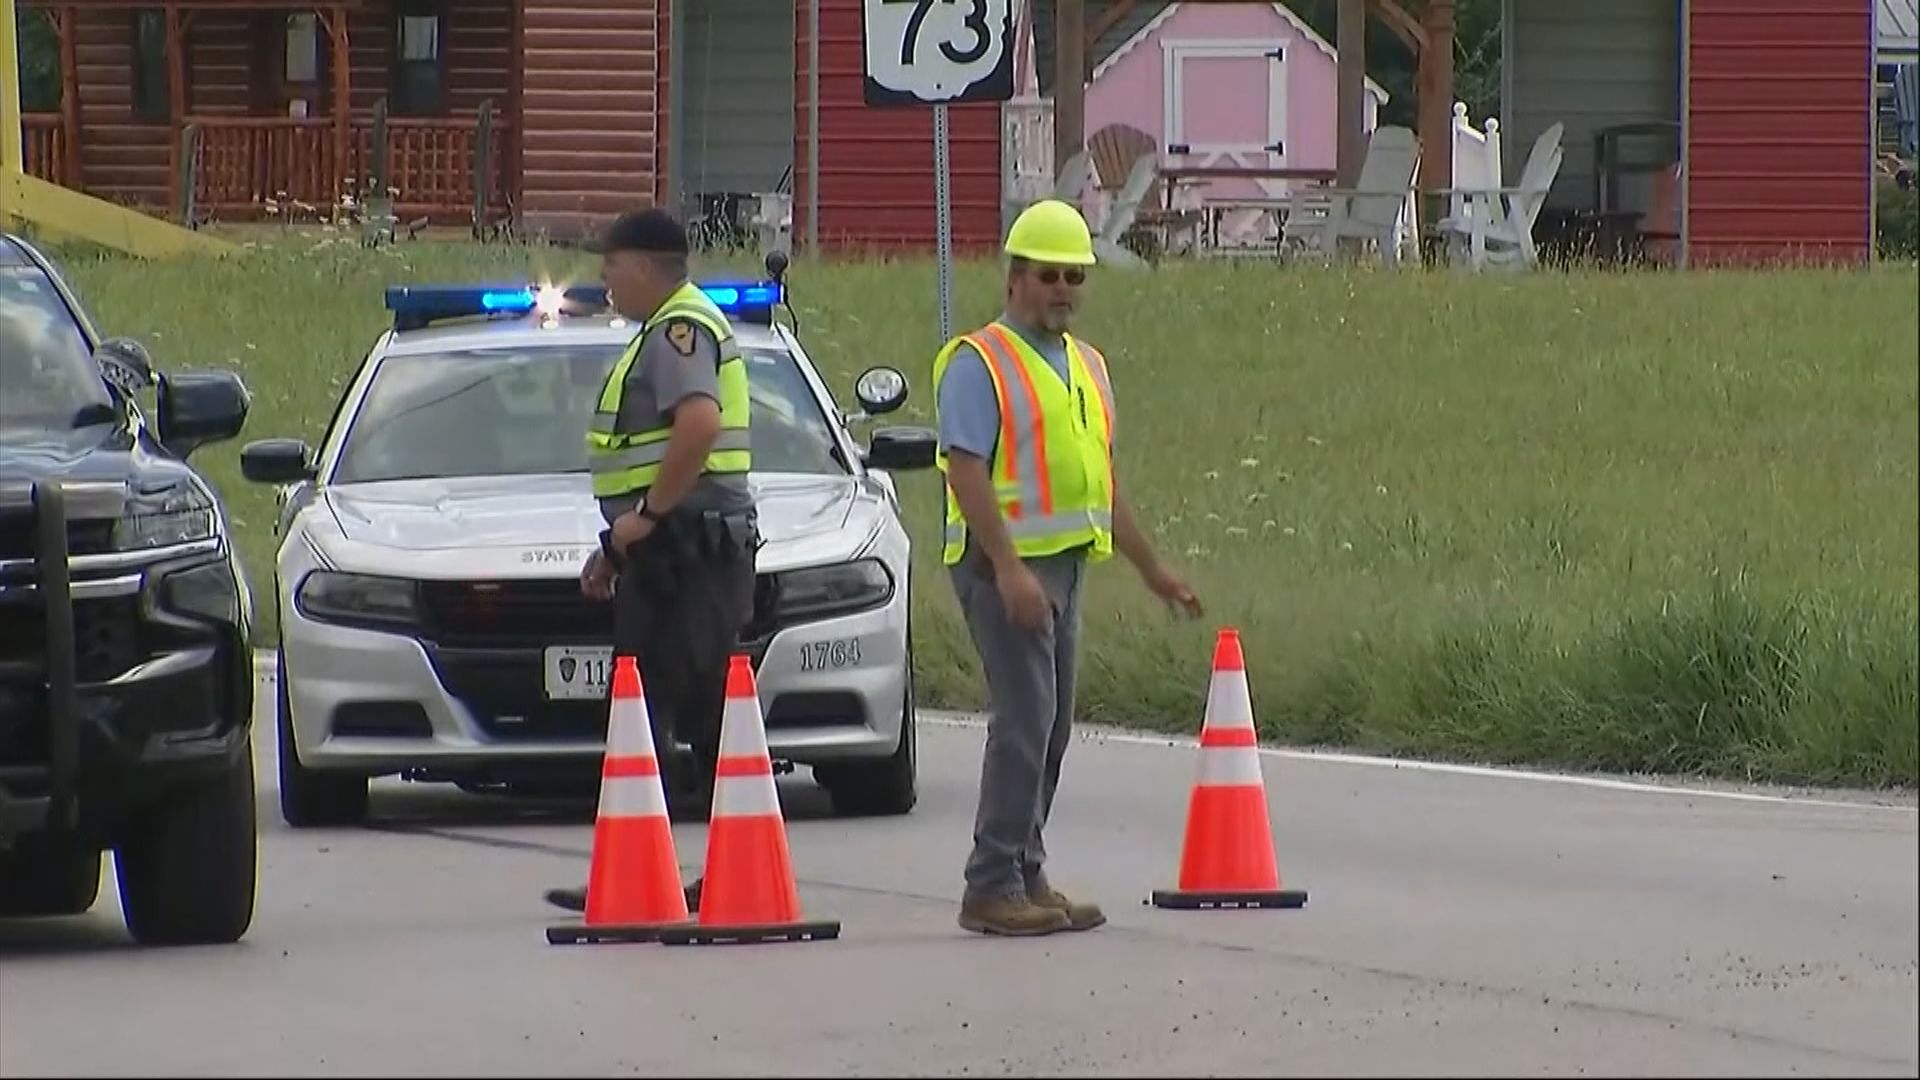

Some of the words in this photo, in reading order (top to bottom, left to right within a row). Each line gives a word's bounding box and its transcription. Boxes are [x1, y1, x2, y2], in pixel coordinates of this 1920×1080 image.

[882, 0, 991, 64] 73
[522, 549, 580, 562] STATE
[801, 637, 861, 671] 1764
[584, 660, 612, 685] 11
